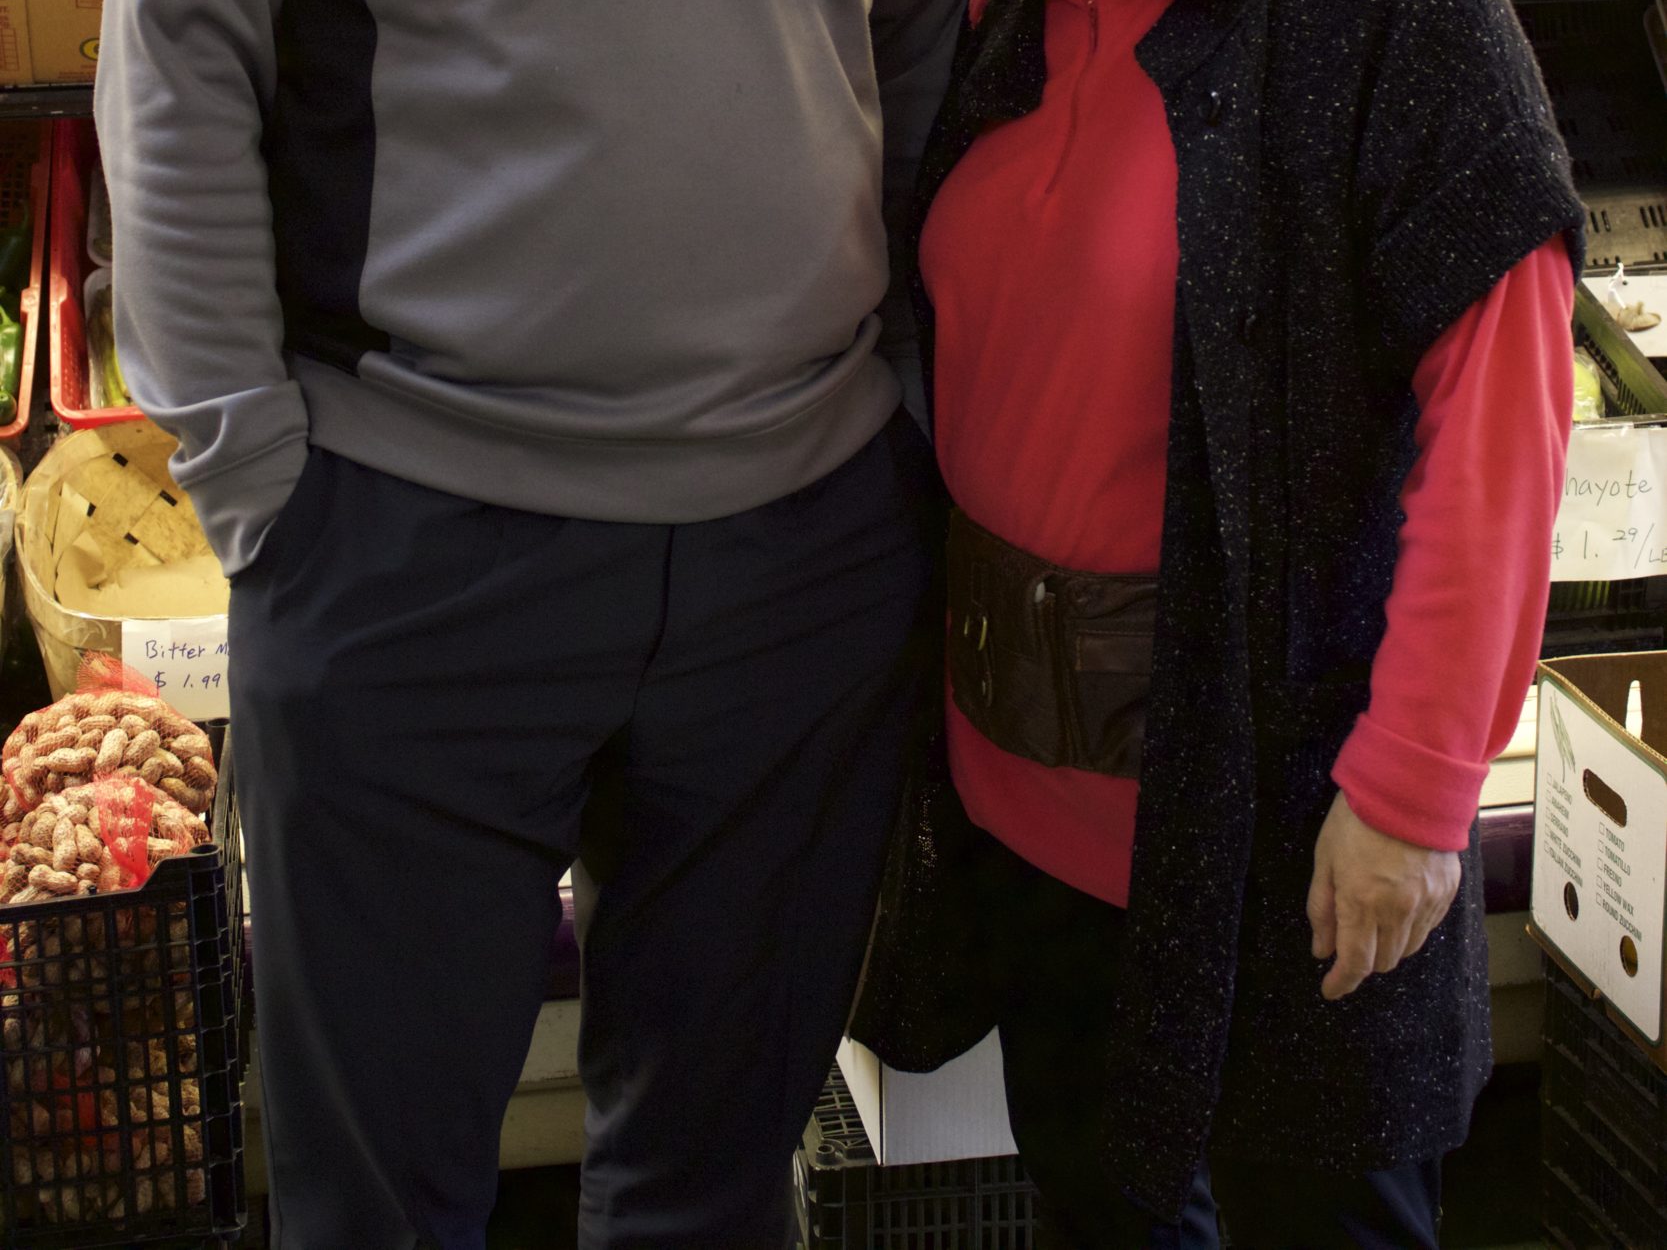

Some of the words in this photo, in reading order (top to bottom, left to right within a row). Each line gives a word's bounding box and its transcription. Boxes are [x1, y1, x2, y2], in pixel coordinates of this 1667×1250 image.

[145, 640, 206, 660] Bitter
[154, 671, 167, 688] $
[183, 673, 221, 690] 1.99
[1605, 828, 1624, 852] TOMATO
[1604, 845, 1630, 876] TOMATILLO
[1602, 880, 1622, 905] YELLOW
